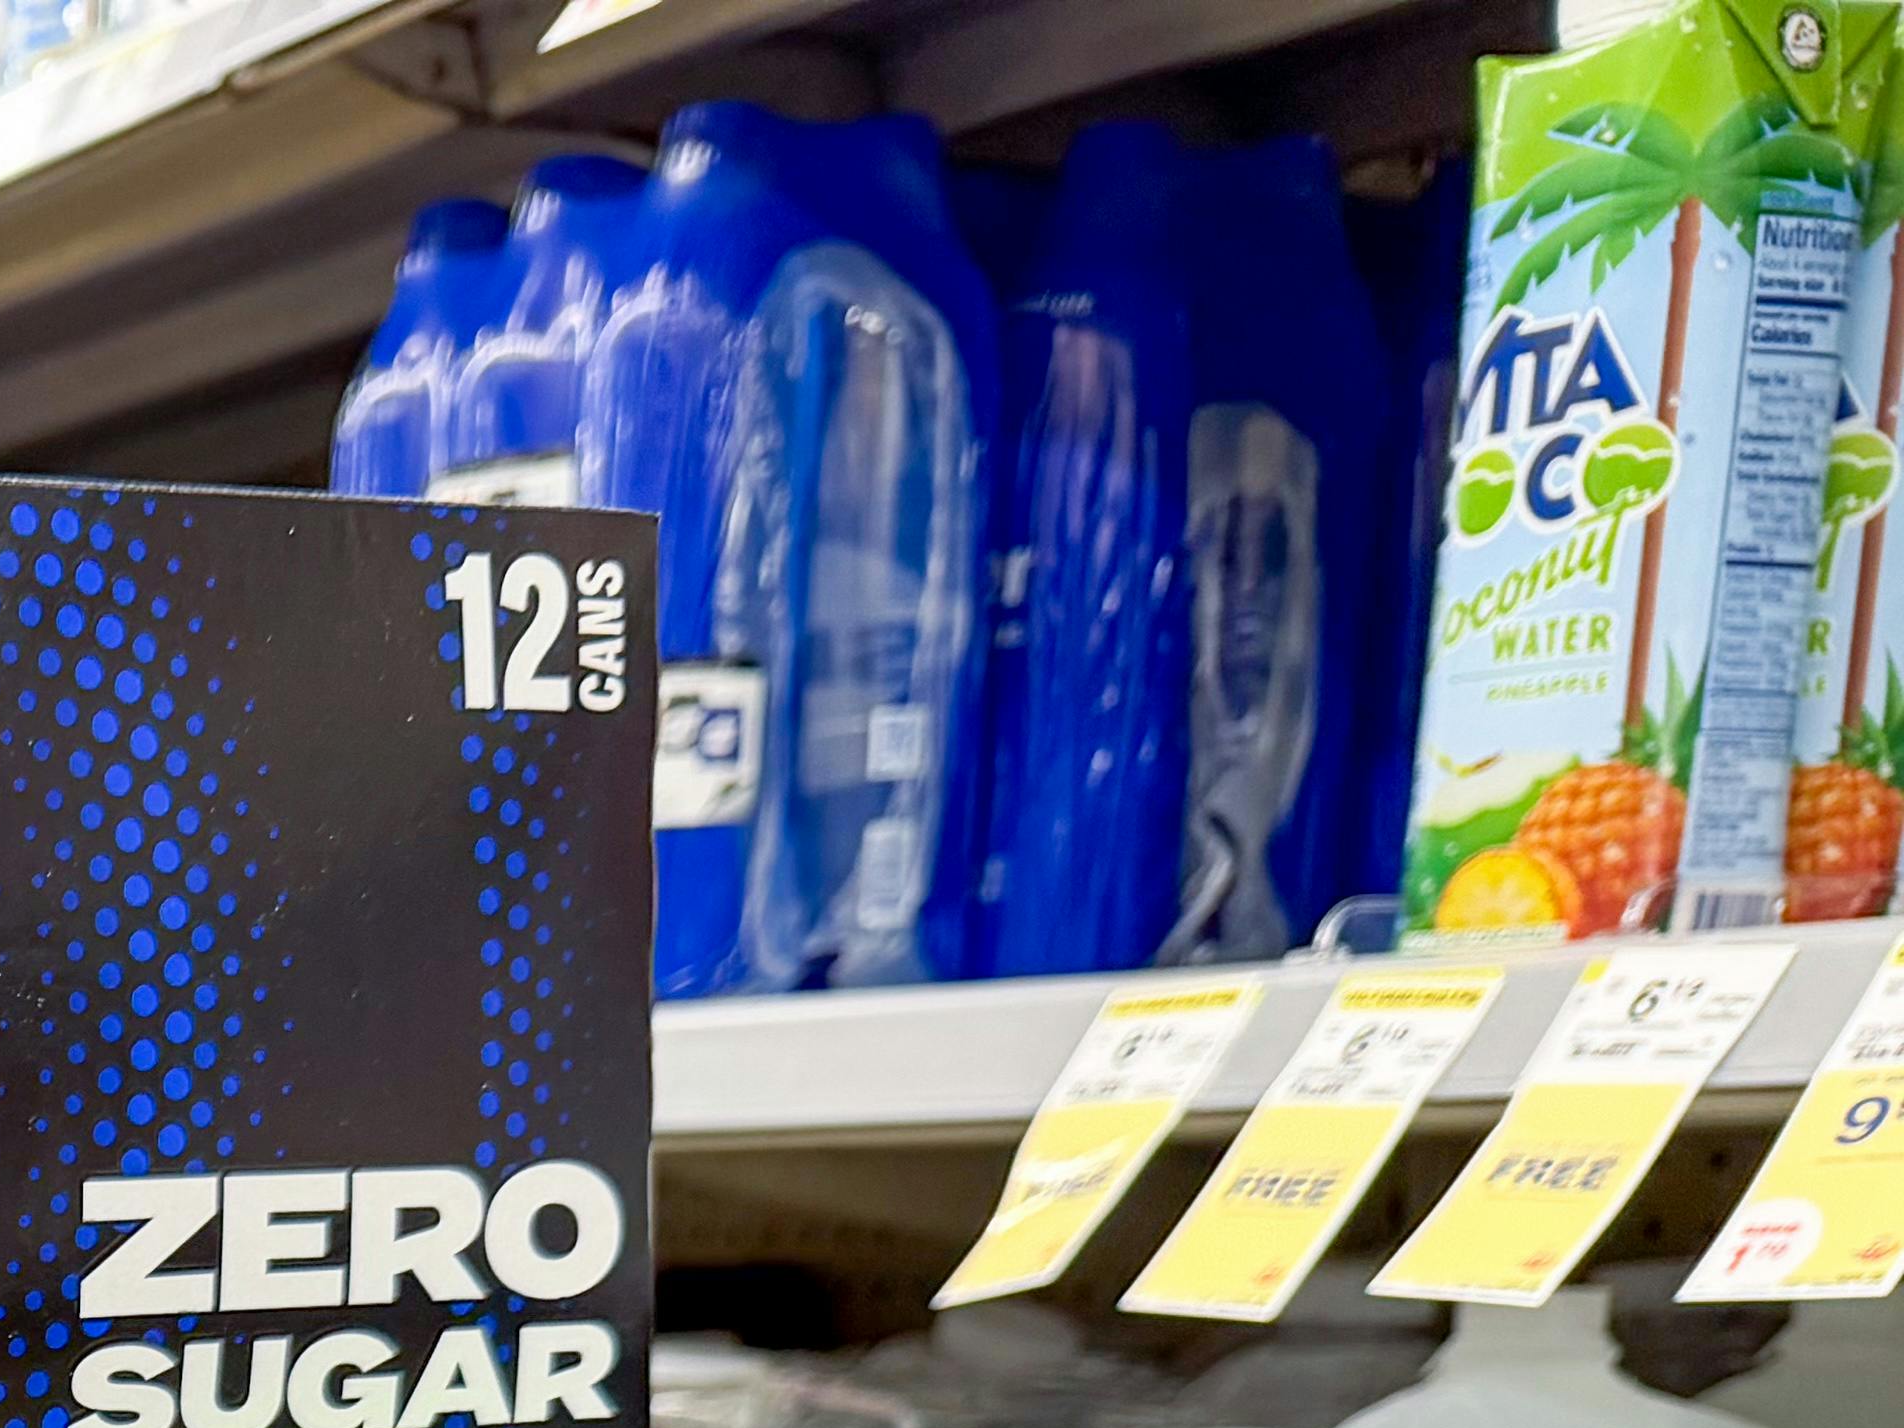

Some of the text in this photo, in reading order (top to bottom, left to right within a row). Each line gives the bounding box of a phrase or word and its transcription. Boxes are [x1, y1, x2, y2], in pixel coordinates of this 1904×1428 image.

[444, 552, 572, 714] 12
[577, 556, 626, 714] CANS
[1493, 613, 1614, 663] WATER
[74, 1159, 624, 1321] ZERO
